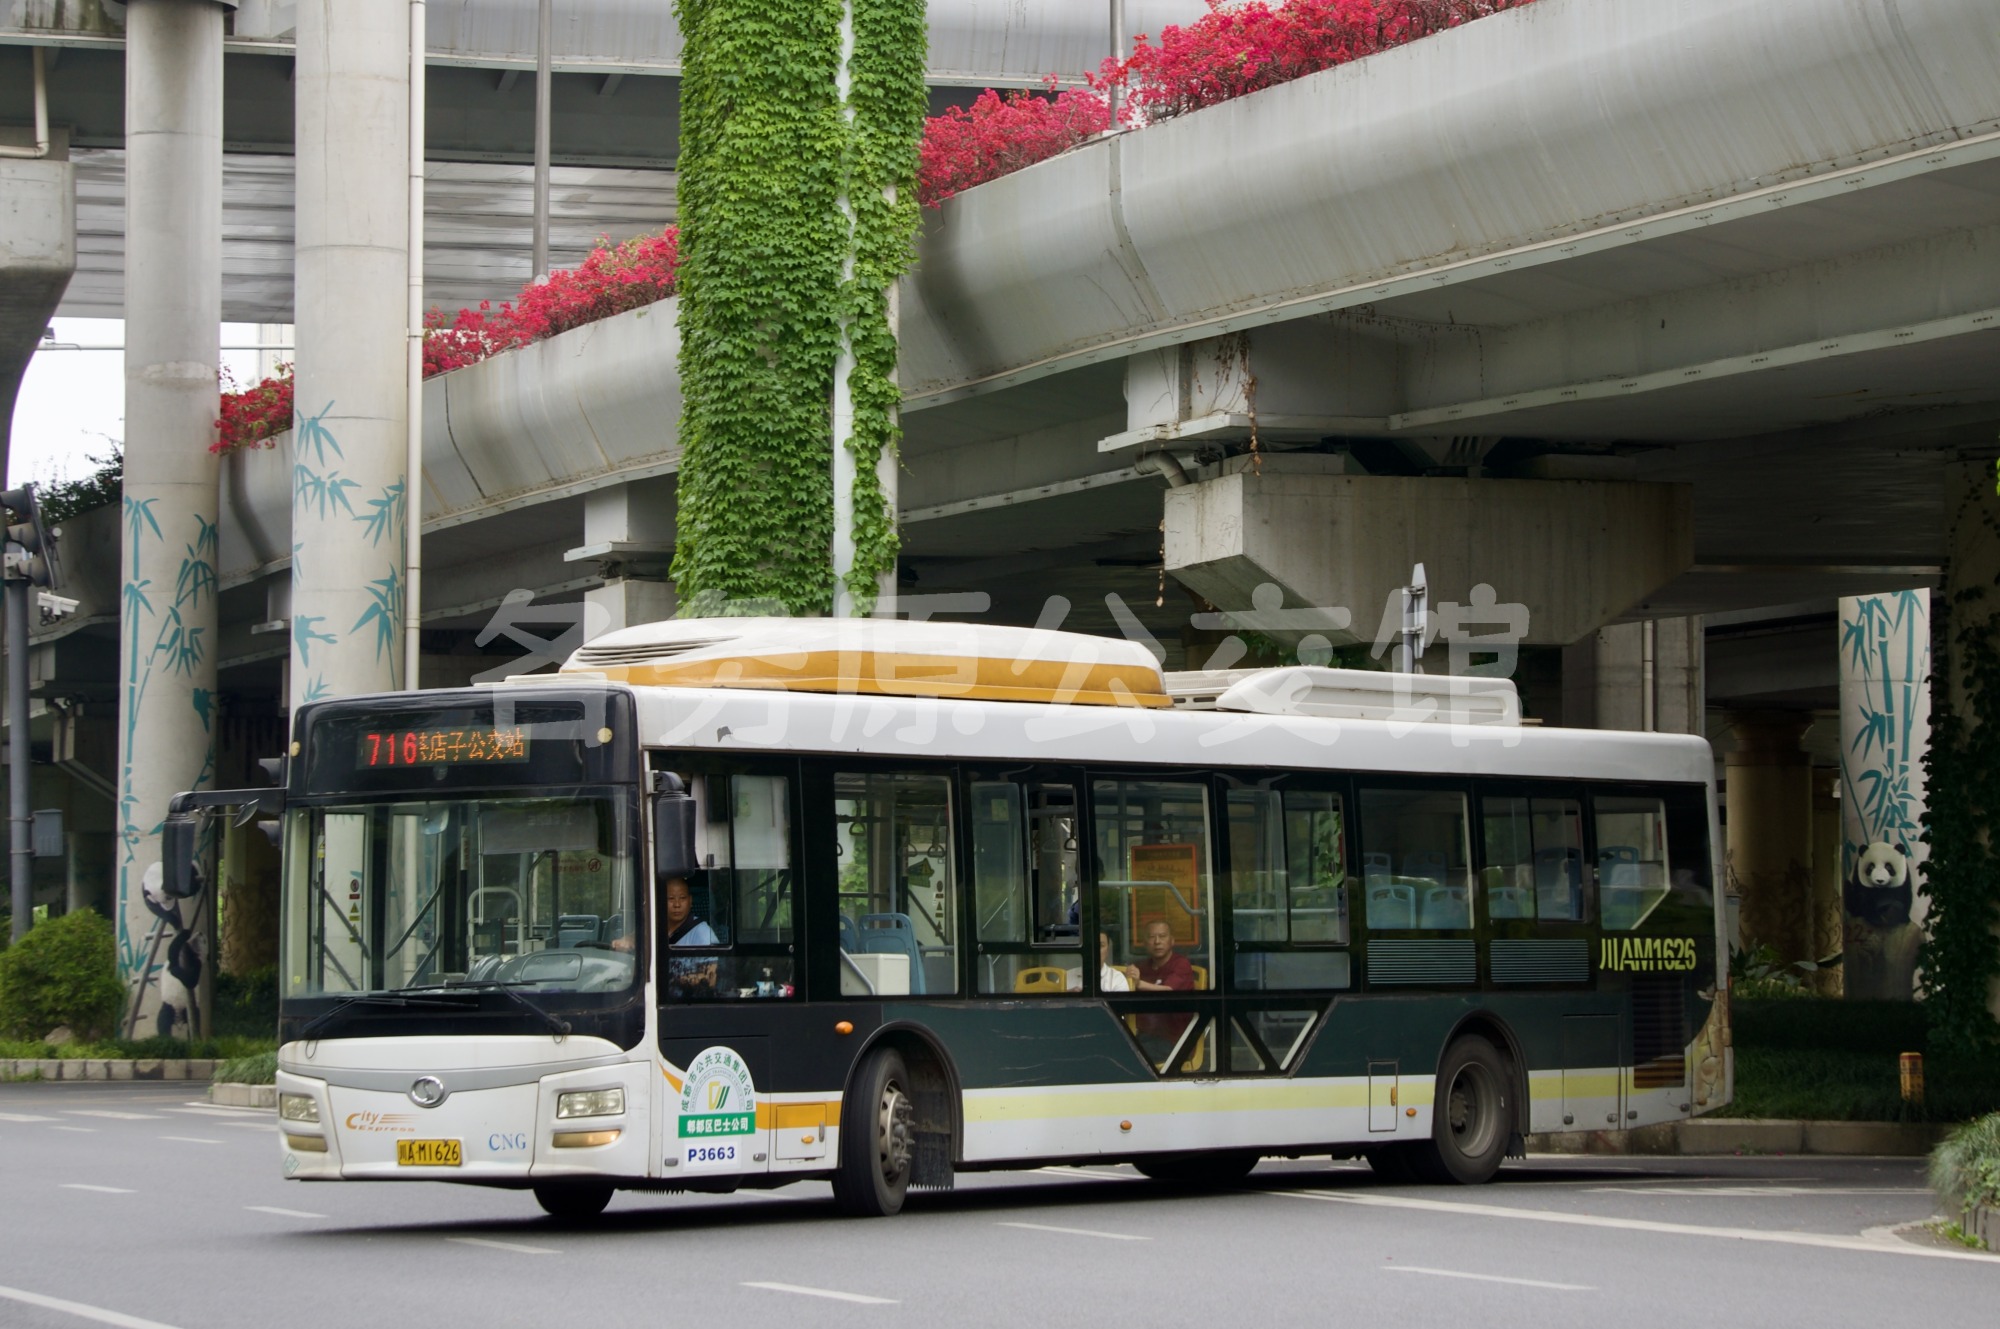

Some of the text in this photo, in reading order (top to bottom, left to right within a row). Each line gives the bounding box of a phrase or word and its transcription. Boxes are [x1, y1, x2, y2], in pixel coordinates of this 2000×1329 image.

[366, 732, 417, 766] 716
[681, 1051, 754, 1112] 成都市公共交通集团公司
[345, 1110, 379, 1130] City
[488, 1133, 527, 1151] CNG
[688, 1146, 735, 1162] P3663
